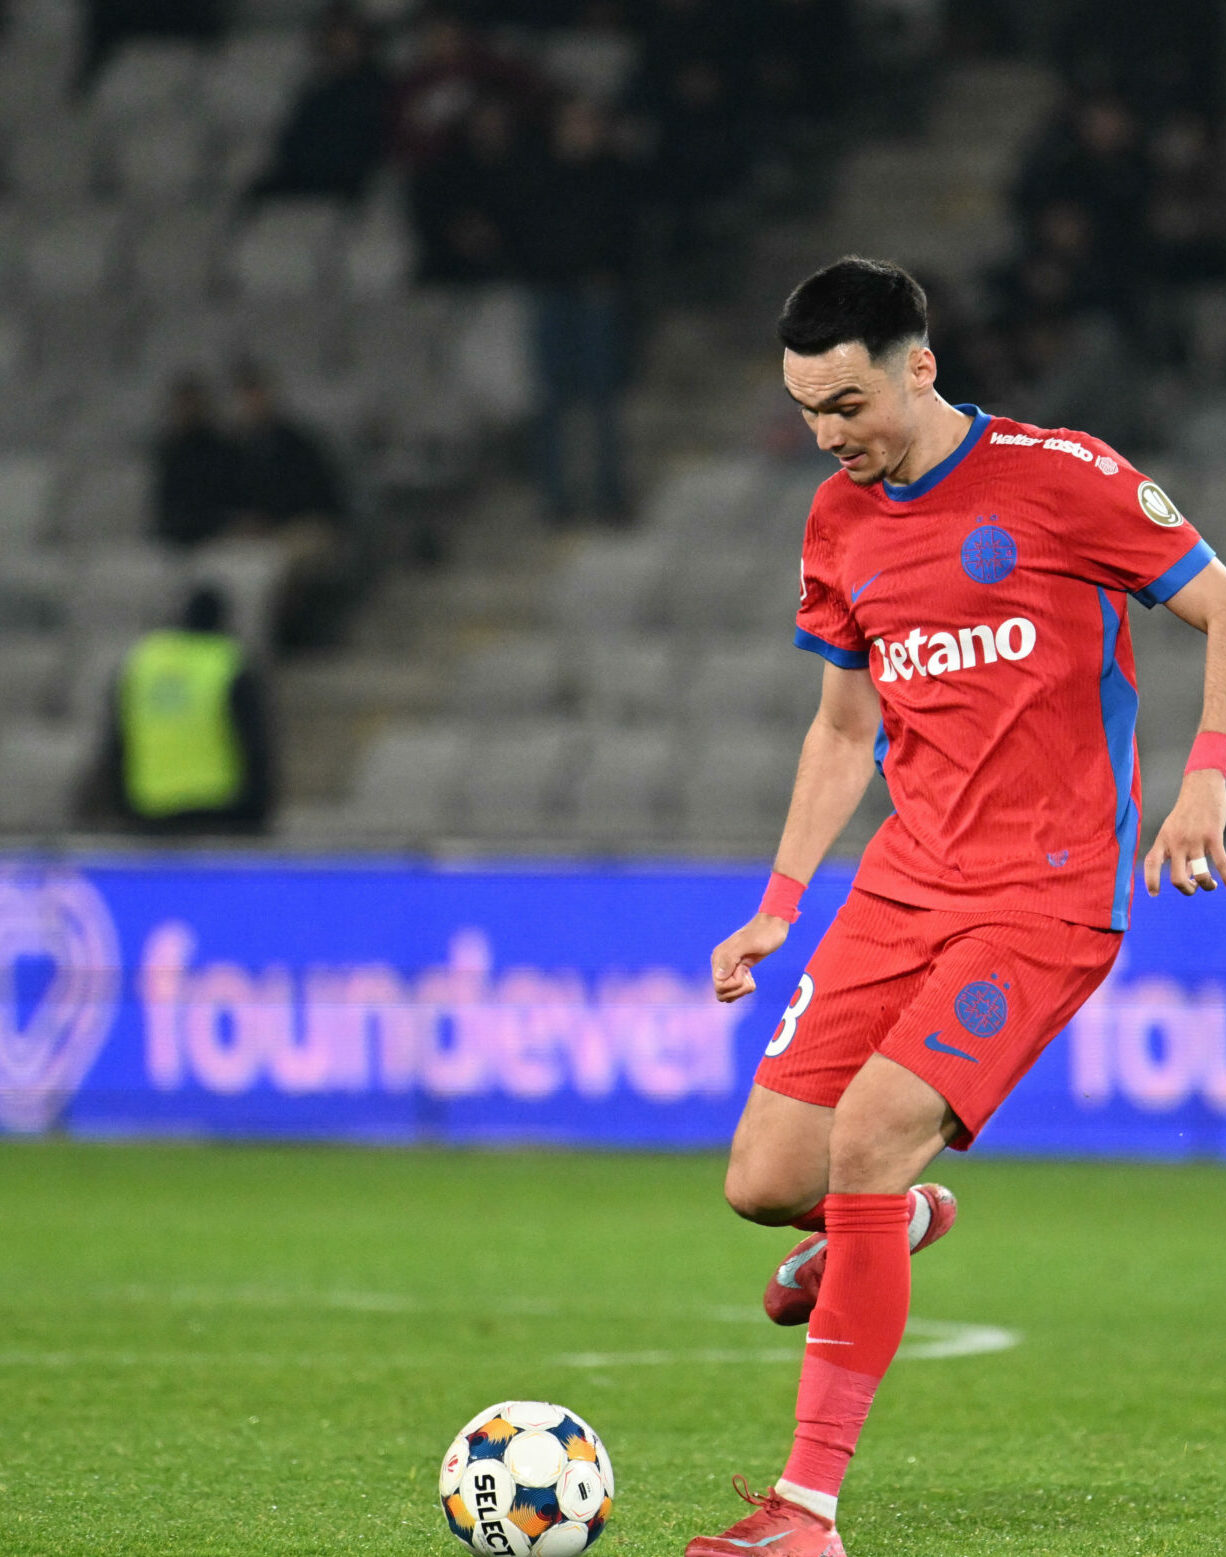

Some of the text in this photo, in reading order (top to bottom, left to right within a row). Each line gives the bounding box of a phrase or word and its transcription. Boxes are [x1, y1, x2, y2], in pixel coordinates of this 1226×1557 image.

[1043, 438, 1093, 462] tosto
[143, 920, 750, 1100] foundever
[474, 1474, 516, 1557] SELECT
